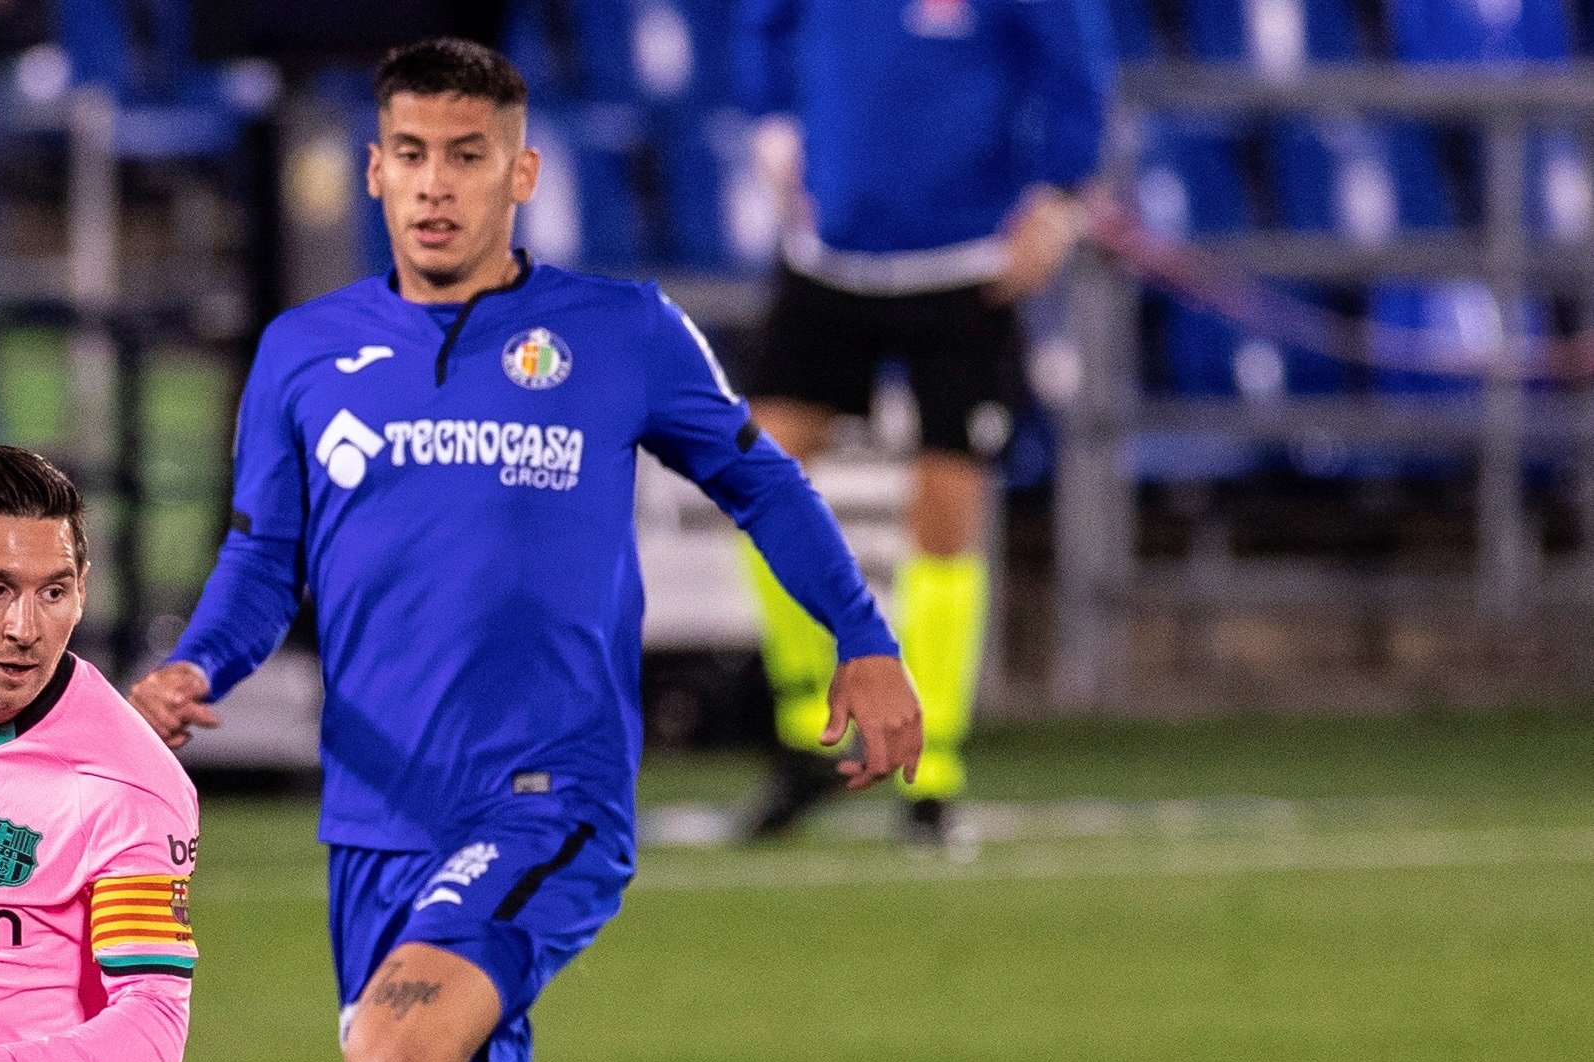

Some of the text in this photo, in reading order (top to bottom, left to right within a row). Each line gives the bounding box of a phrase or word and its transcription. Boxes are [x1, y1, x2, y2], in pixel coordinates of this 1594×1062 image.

[384, 418, 583, 473] TECNOCASA
[499, 465, 579, 491] GROUP
[167, 834, 199, 866] be
